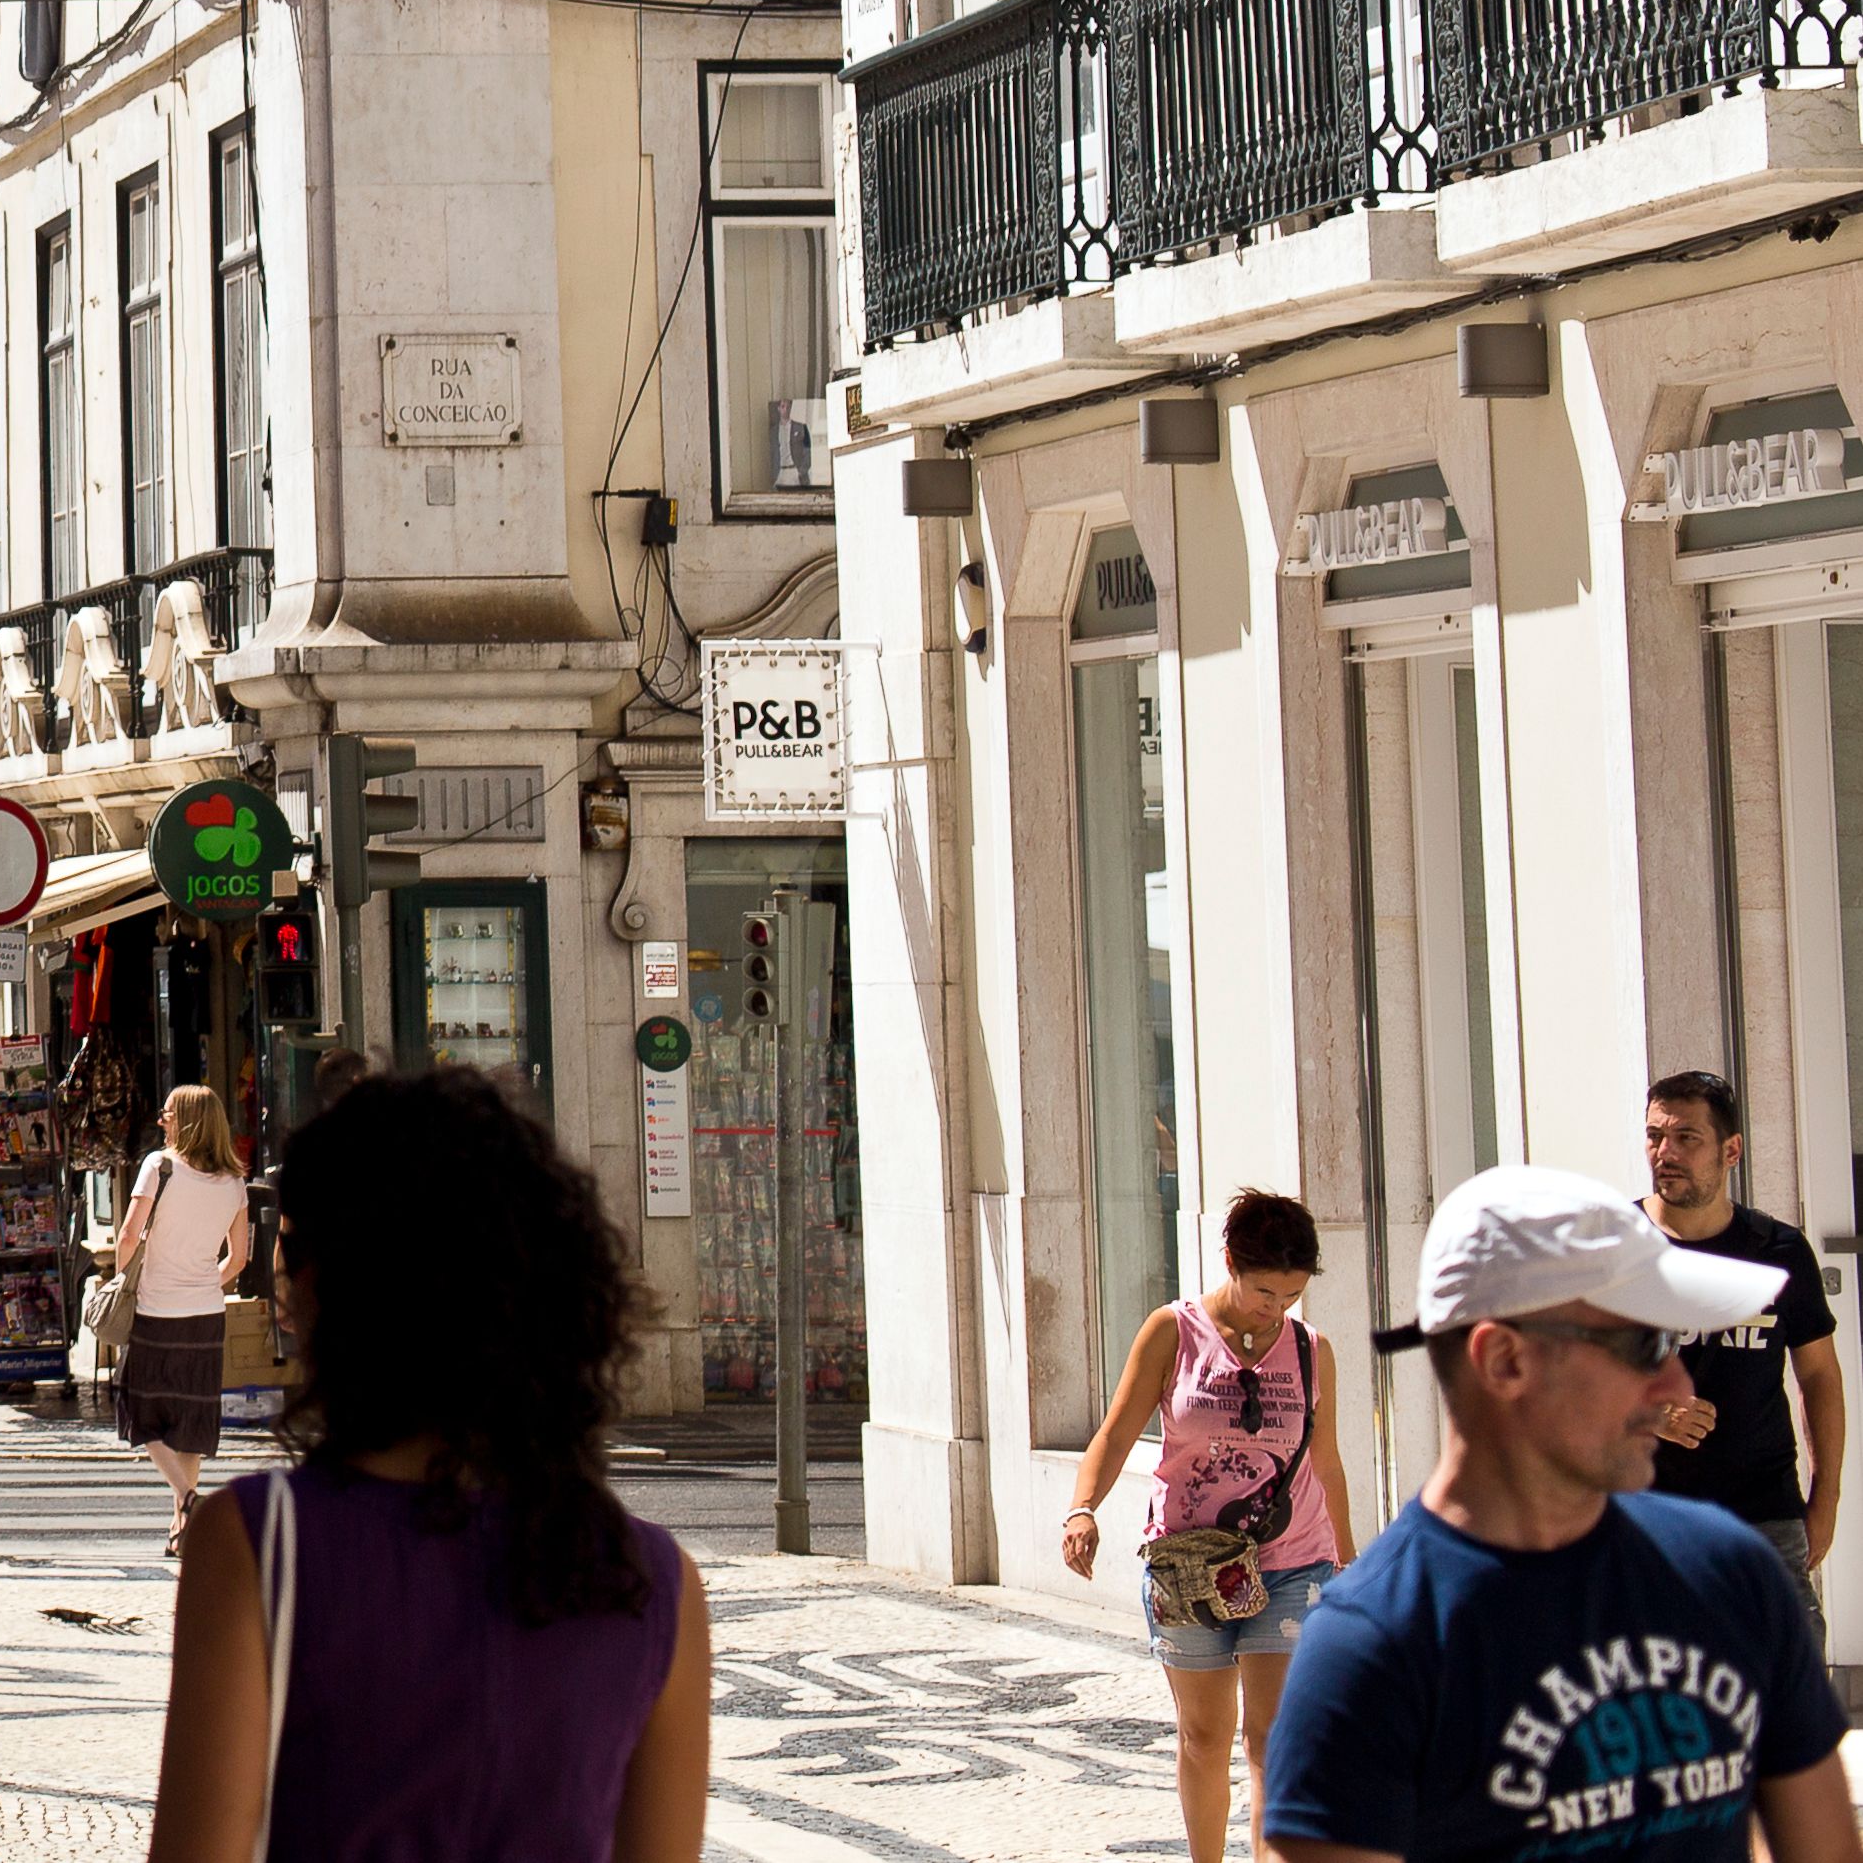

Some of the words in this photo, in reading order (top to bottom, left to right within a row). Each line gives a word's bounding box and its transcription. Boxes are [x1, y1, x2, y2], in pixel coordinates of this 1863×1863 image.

[431, 358, 472, 376] RUA
[440, 382, 464, 399] DA
[1665, 429, 1826, 512] PULL&BEAR
[1308, 498, 1431, 568] PULL&BEAR
[1095, 553, 1156, 611] PULL&
[732, 699, 822, 740] P&B
[735, 744, 824, 758] PULL&BEAR
[186, 875, 260, 904] JOGOS
[1186, 1396, 1215, 1409] FUNNY
[1218, 1399, 1240, 1411] TEES
[1575, 1691, 1712, 1785] 1919
